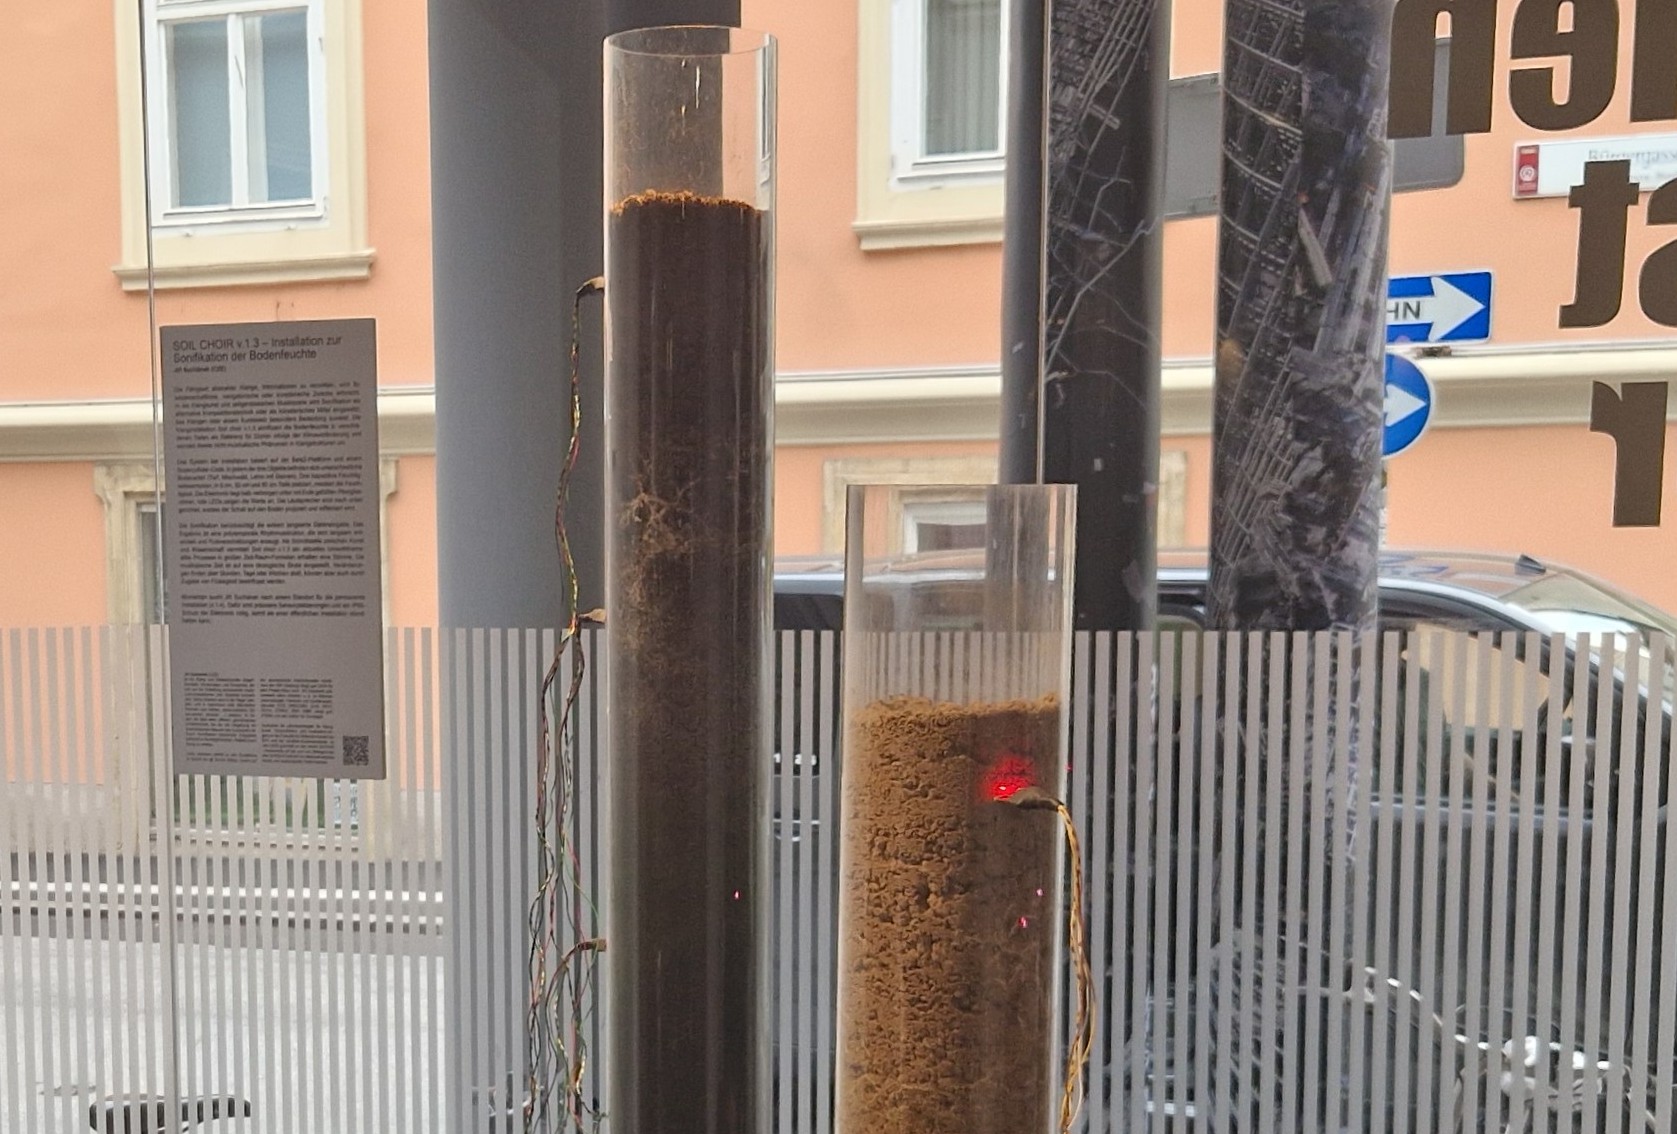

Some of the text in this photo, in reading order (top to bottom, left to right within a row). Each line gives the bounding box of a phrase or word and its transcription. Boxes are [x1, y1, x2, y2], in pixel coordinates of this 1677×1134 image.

[1387, 301, 1421, 320] HN
[172, 340, 196, 351] SOIL
[200, 338, 235, 350] CHOIR
[271, 335, 323, 347] Installation
[326, 335, 342, 346] zur
[173, 348, 317, 363] Sonifikation der Bodenfeuchte
